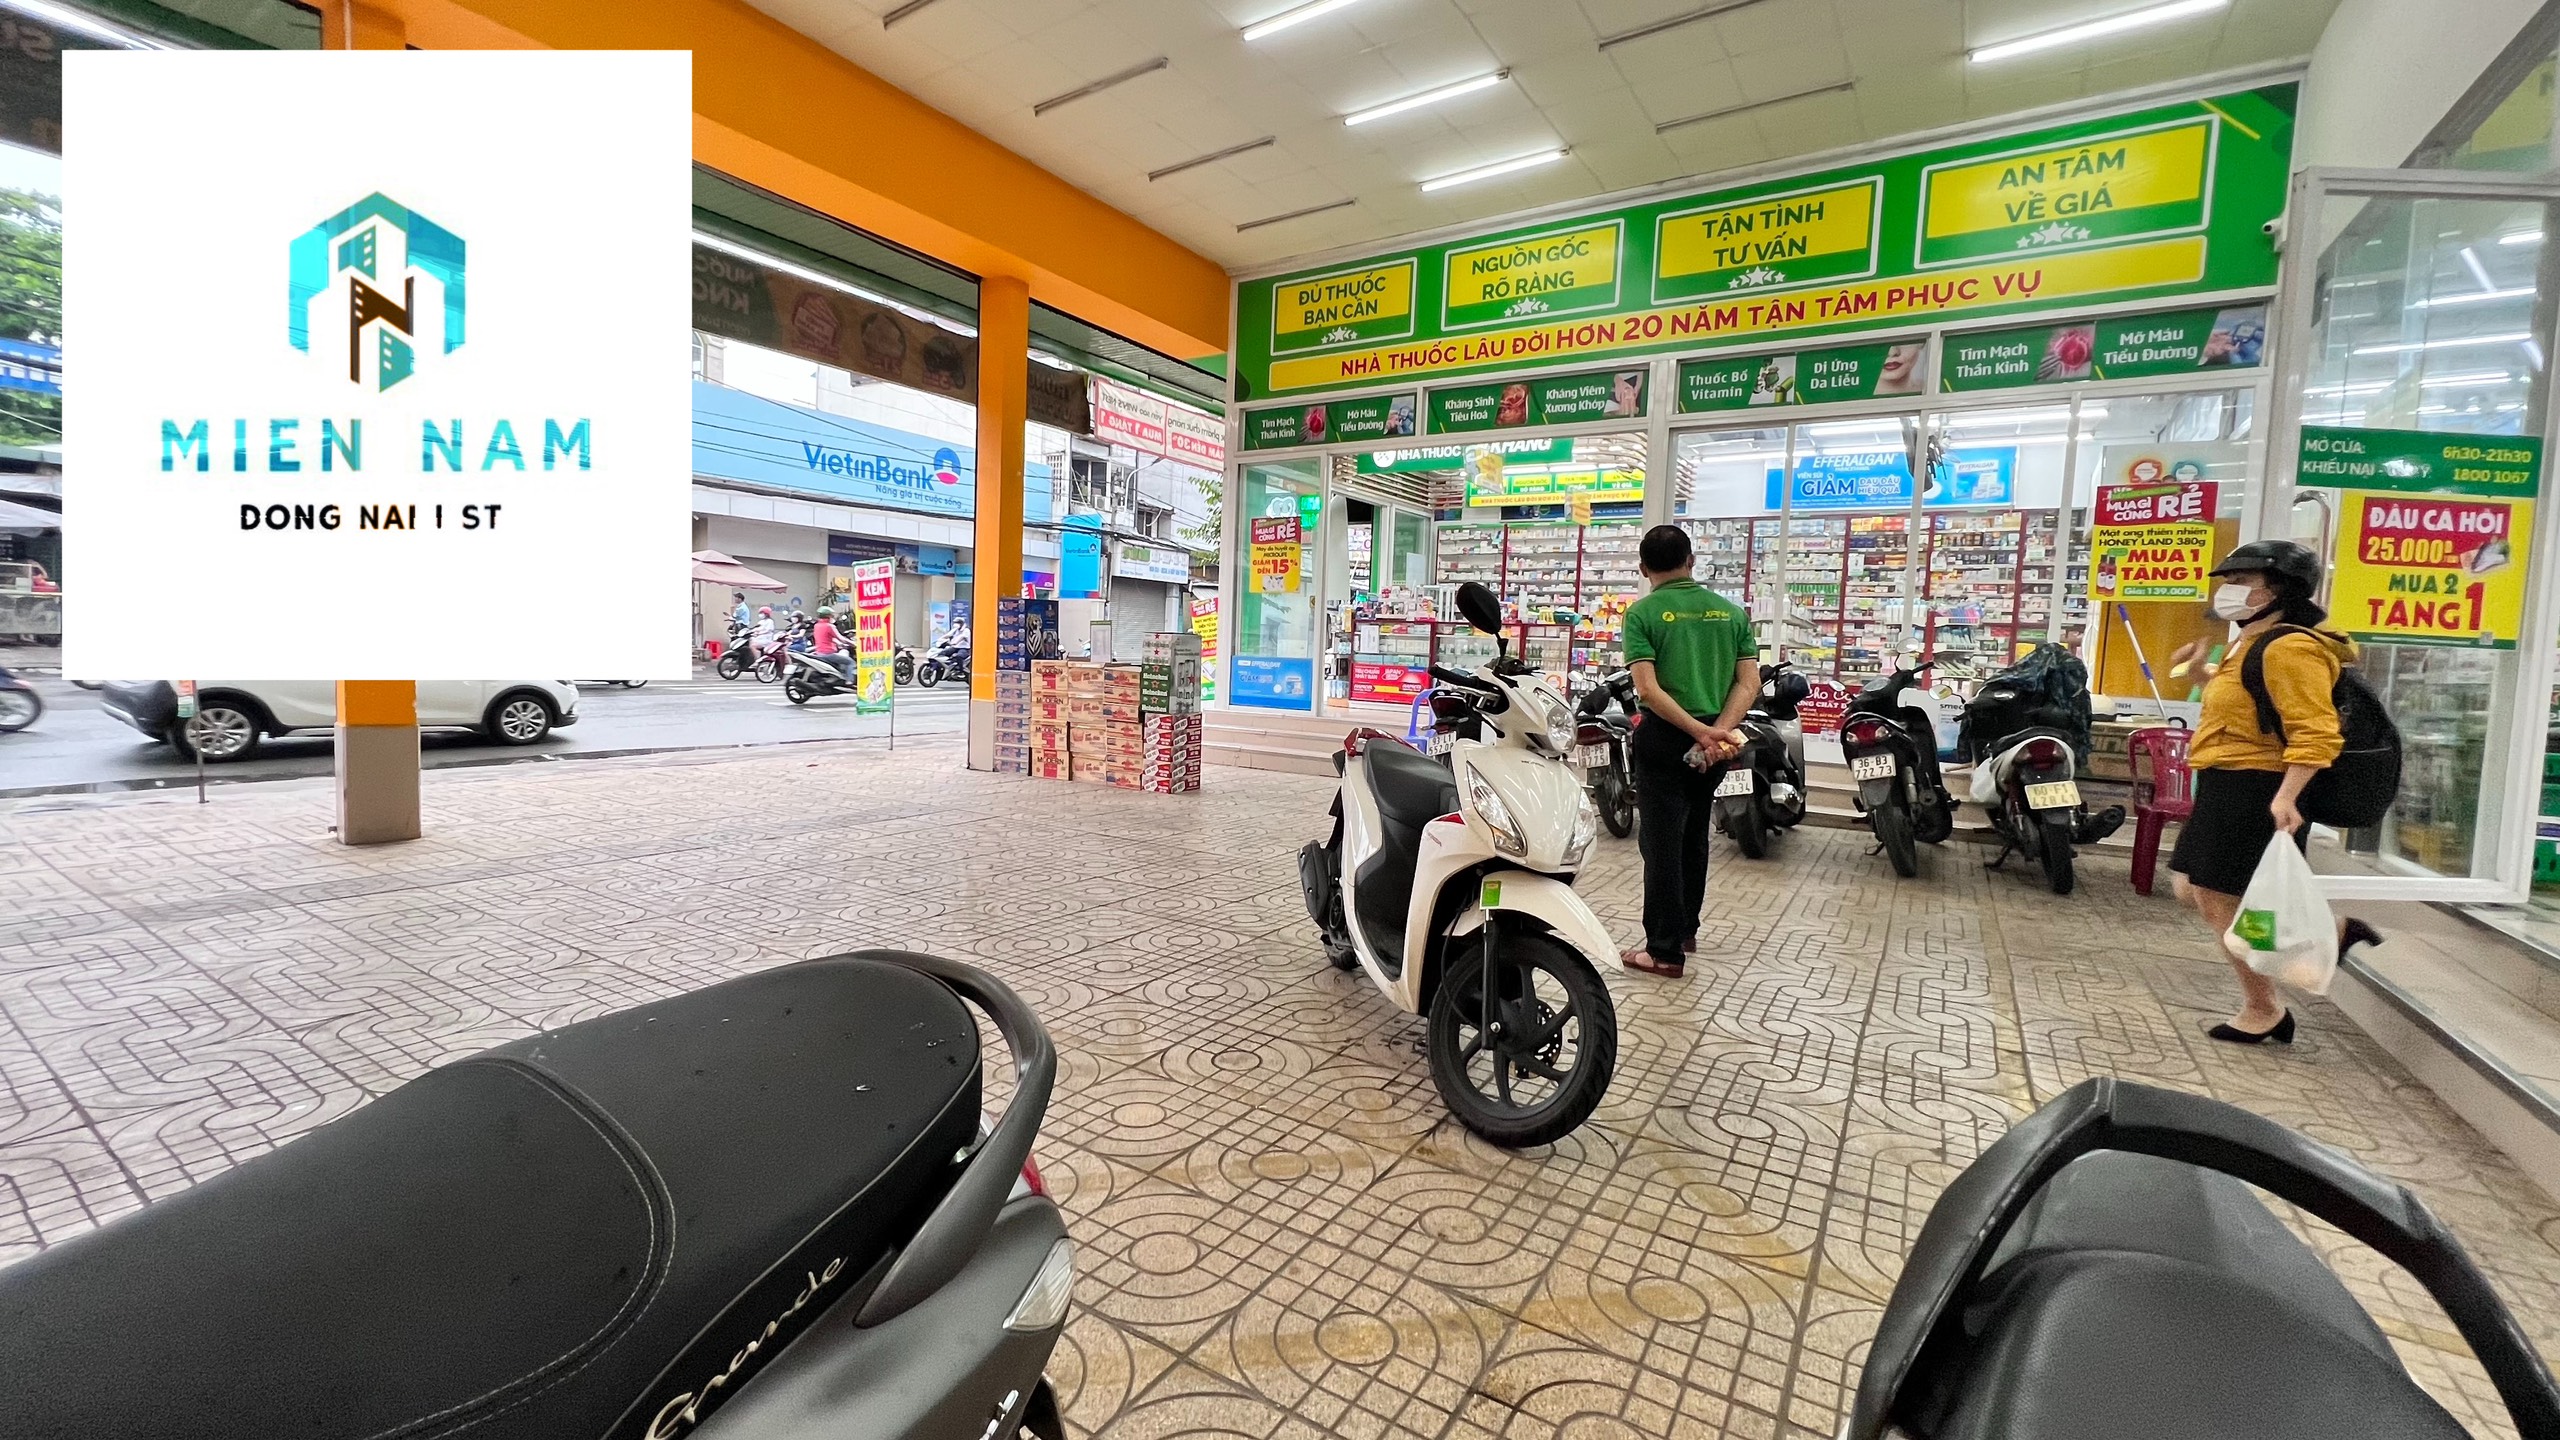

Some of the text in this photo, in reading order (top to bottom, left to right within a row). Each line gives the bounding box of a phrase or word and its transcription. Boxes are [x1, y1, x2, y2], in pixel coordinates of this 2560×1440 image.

[1998, 148, 2126, 190] AN TÂM
[2004, 181, 2113, 223] VỀ GIÁ
[1702, 201, 1824, 241] TẬN TÌNH
[1472, 235, 1590, 275] NGUỒN GỐC
[1713, 231, 1807, 267] TƯ VẤN
[1299, 272, 1386, 306] ĐỦ THUỐC
[1482, 271, 1575, 300] RÕ RÀNG
[1304, 297, 1378, 327] BẠN CẦN
[1341, 270, 2042, 376] NHÀ THUỐC LÂU ĐỜI HƠN 20 NĂM TẬN TÂM PHỤC VỤ
[2120, 329, 2184, 346] Mỡ Máu
[1960, 343, 2028, 361] Tim Mạch
[2103, 345, 2198, 365] Tiểu Đường
[1814, 358, 1858, 375] Dị Ứng
[1957, 360, 2028, 378] Thần Kinh
[1689, 369, 1748, 386] Thuốc Bổ
[1810, 374, 1860, 389] Da Liễu
[1546, 385, 1605, 400] Kháng Viêm
[1692, 386, 1742, 400] Vitamin
[1445, 396, 1494, 411] Kháng Sinh
[1545, 399, 1605, 414] Xương Khớp
[1360, 408, 1377, 418] Máu
[1450, 409, 1488, 422] Tiêu Hoá
[1262, 416, 1295, 428] Tim Mạch
[1340, 421, 1384, 433] Tiểu Đường
[1260, 429, 1296, 440] Thần Kinh
[2305, 438, 2329, 453] MỞ
[1813, 453, 1895, 468] EFFERALGAN
[2442, 446, 2532, 464] 6h30-21h30
[802, 440, 935, 491] VietinBank
[2302, 457, 2347, 474] KHIẾU
[2453, 468, 2531, 484] 1800 1067
[1801, 473, 1855, 497] GIẢM
[2157, 484, 2203, 518] RẺ
[2423, 508, 2454, 531] CÁ
[2459, 507, 2504, 534] HỒI
[2098, 537, 2206, 548] HONEY LAND 380g
[2127, 549, 2200, 563] MUA 1
[2121, 564, 2203, 585] TẶNG 1
[862, 581, 887, 598] KEM
[2388, 573, 2459, 595] MUA 2
[2367, 582, 2485, 631] TẶNG 1
[859, 614, 882, 631] MUA
[884, 612, 891, 650] 1
[1858, 756, 1887, 768] 36-B3
[1855, 765, 1892, 778] 722.73
